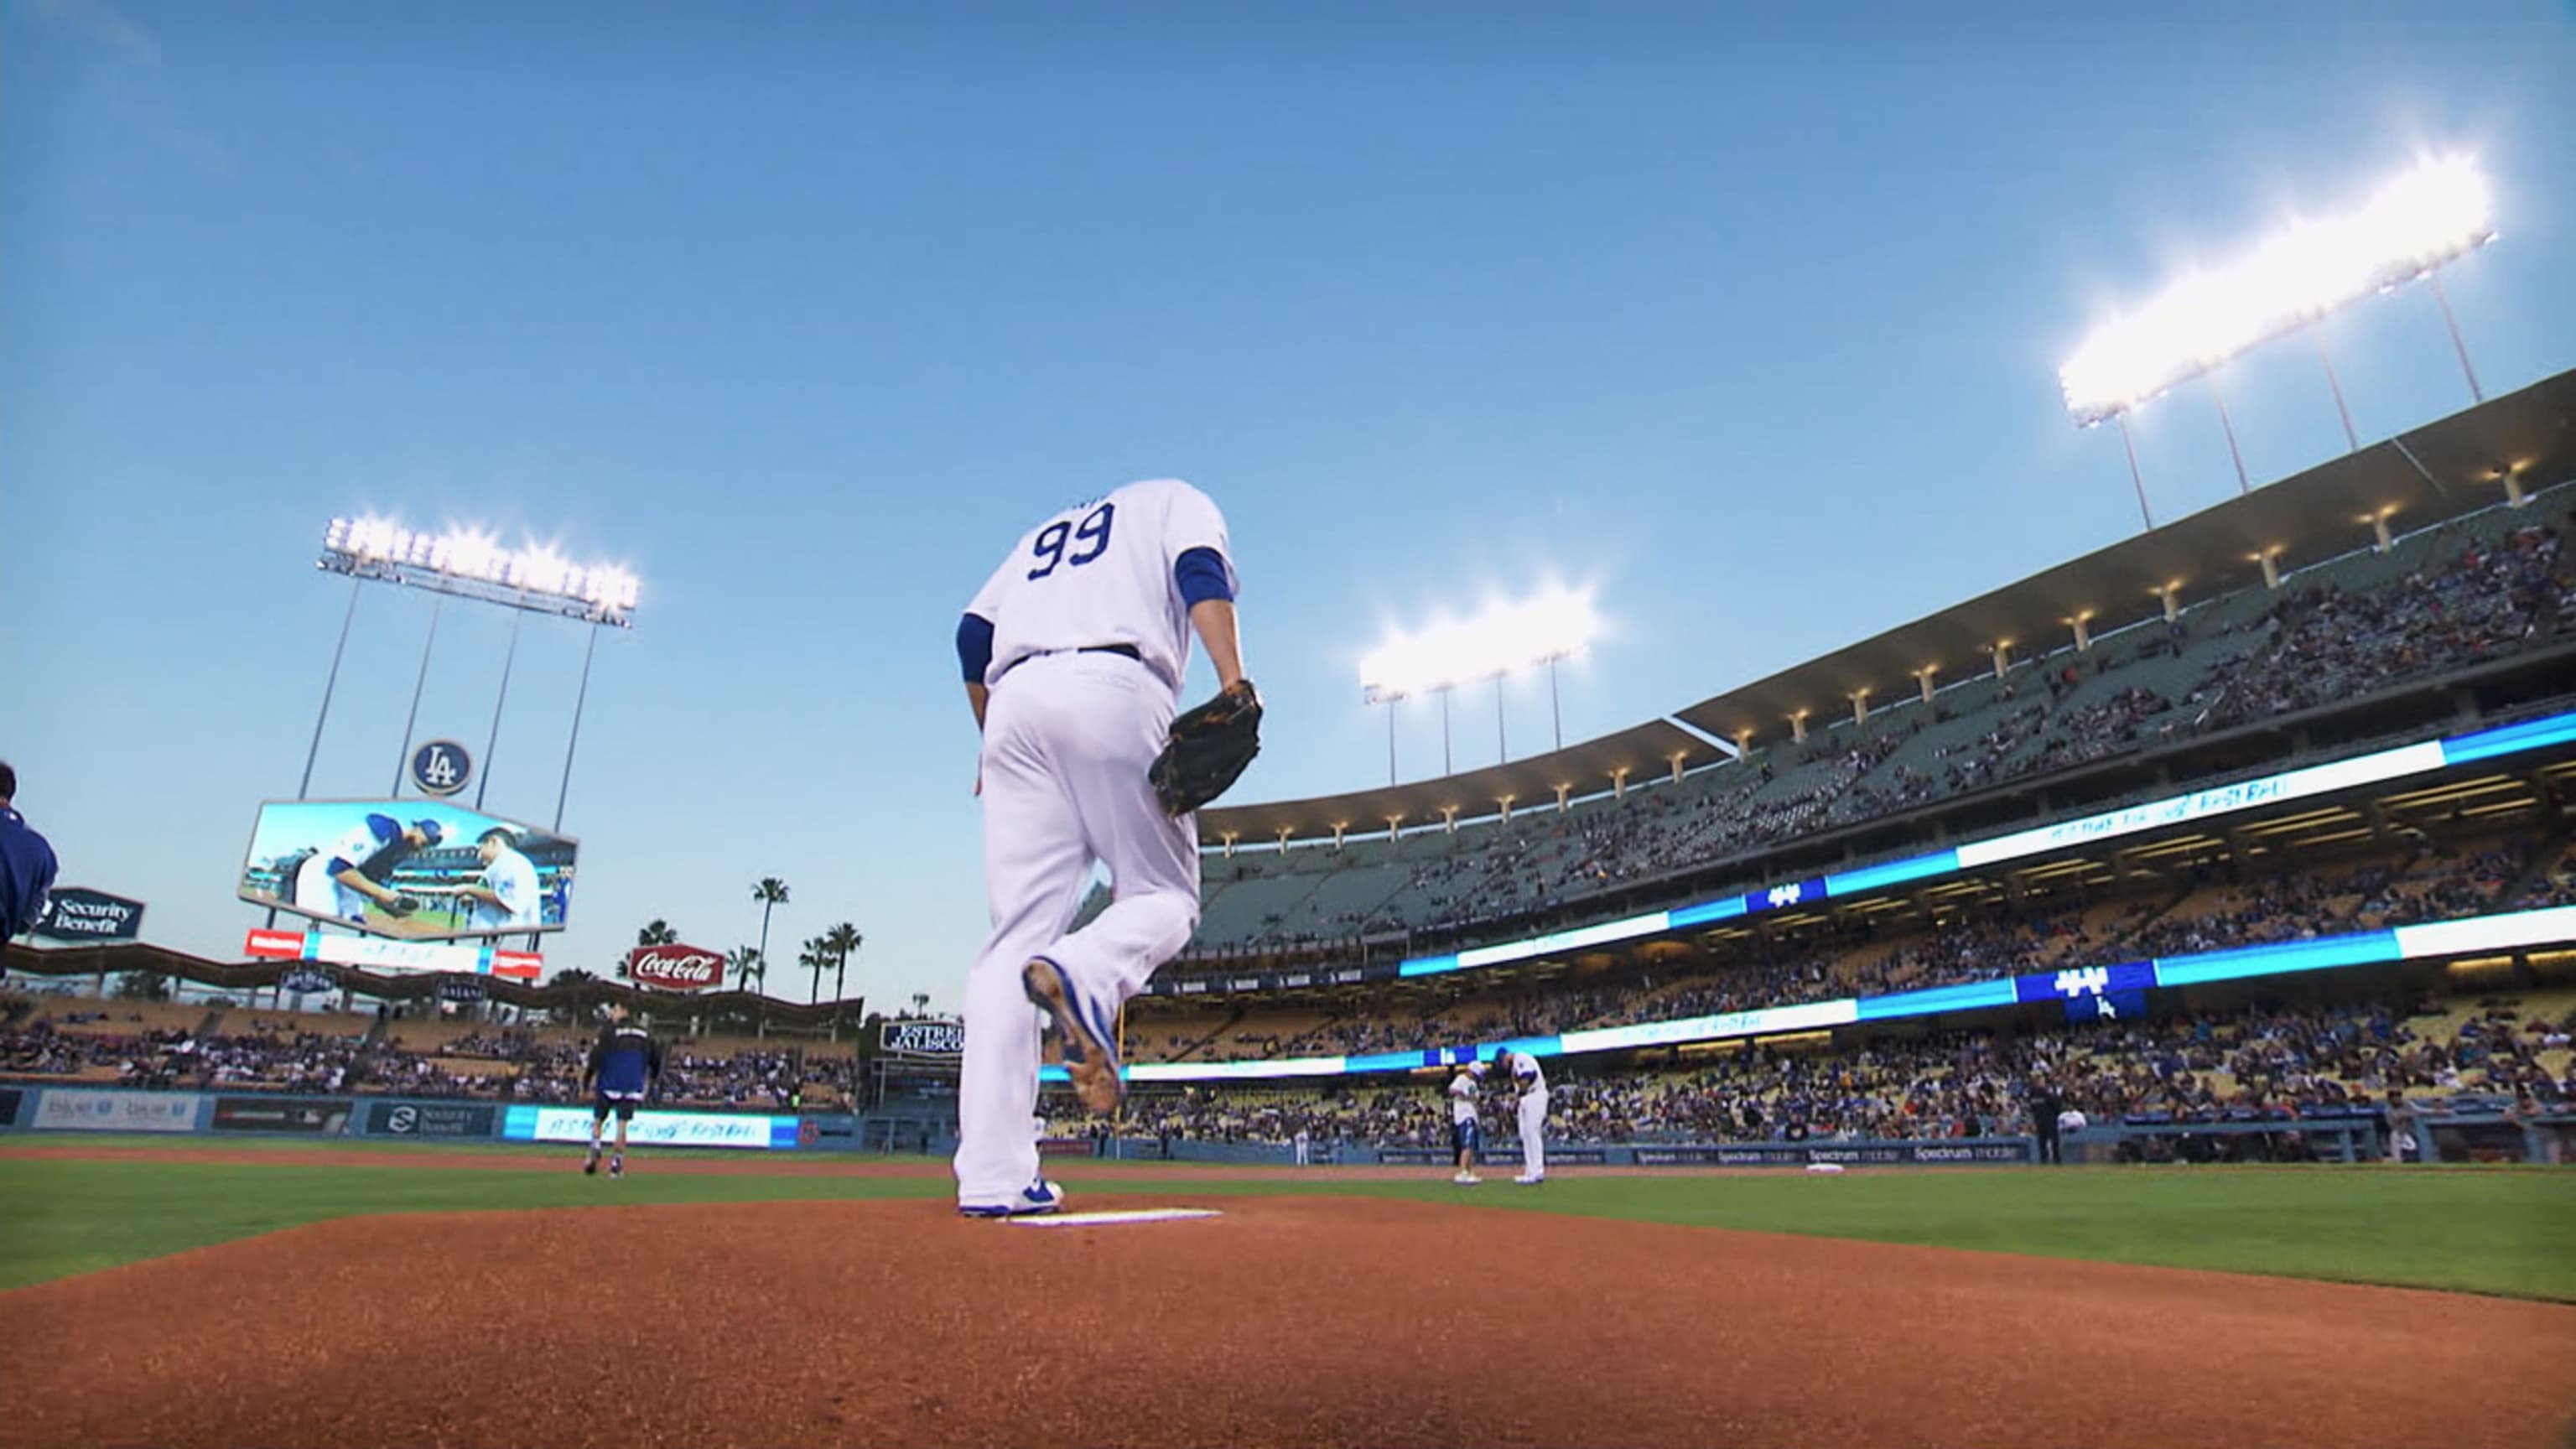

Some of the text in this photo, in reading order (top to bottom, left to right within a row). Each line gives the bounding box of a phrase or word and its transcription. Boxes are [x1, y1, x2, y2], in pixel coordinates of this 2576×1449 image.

[1027, 502, 1115, 581] 99
[426, 745, 457, 786] LA
[60, 899, 132, 922] Security
[54, 913, 118, 934] Benefit
[891, 1036, 963, 1052] JALISCO
[1808, 1149, 1859, 1163] Spectrum
[1914, 1146, 1972, 1161] Spectrum
